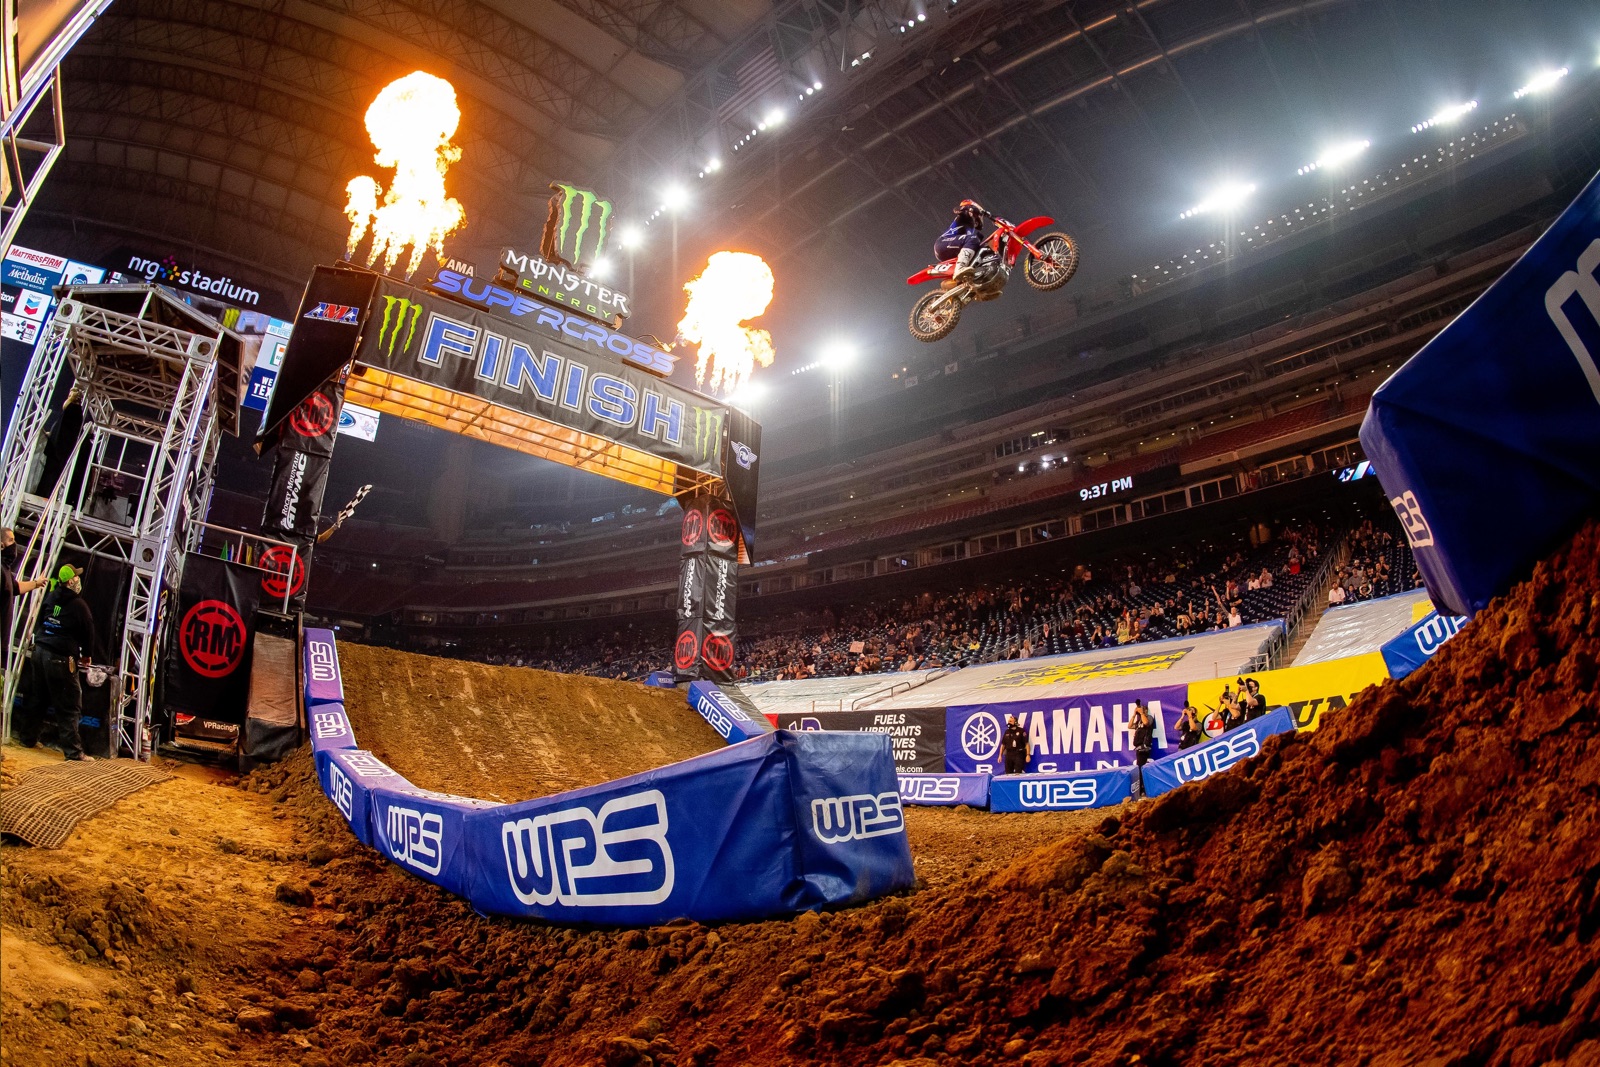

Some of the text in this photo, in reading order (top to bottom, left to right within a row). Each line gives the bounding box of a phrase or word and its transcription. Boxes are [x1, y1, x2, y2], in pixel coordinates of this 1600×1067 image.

[8, 268, 47, 286] Methodist
[128, 255, 260, 305] nrg stadium
[446, 258, 475, 277] AMA
[303, 302, 360, 326] AMA
[522, 278, 612, 319] ENERGY
[432, 269, 681, 373] SUPERCROSS
[417, 310, 687, 448] FINISH
[282, 451, 300, 516] ROCKY MOUNTAIN
[1080, 476, 1133, 501] 9:37 PM
[190, 618, 235, 658] RM
[1414, 614, 1469, 655] WP
[698, 695, 732, 738] WPS
[709, 690, 751, 721] WPS
[874, 713, 906, 725] FUELS
[1174, 728, 1260, 784] WPS
[330, 762, 352, 822] WPS
[897, 777, 960, 801] WPS
[1019, 778, 1097, 808] WPS
[810, 791, 905, 844] WPS
[387, 804, 443, 876] WPS
[502, 788, 676, 907] WPS
